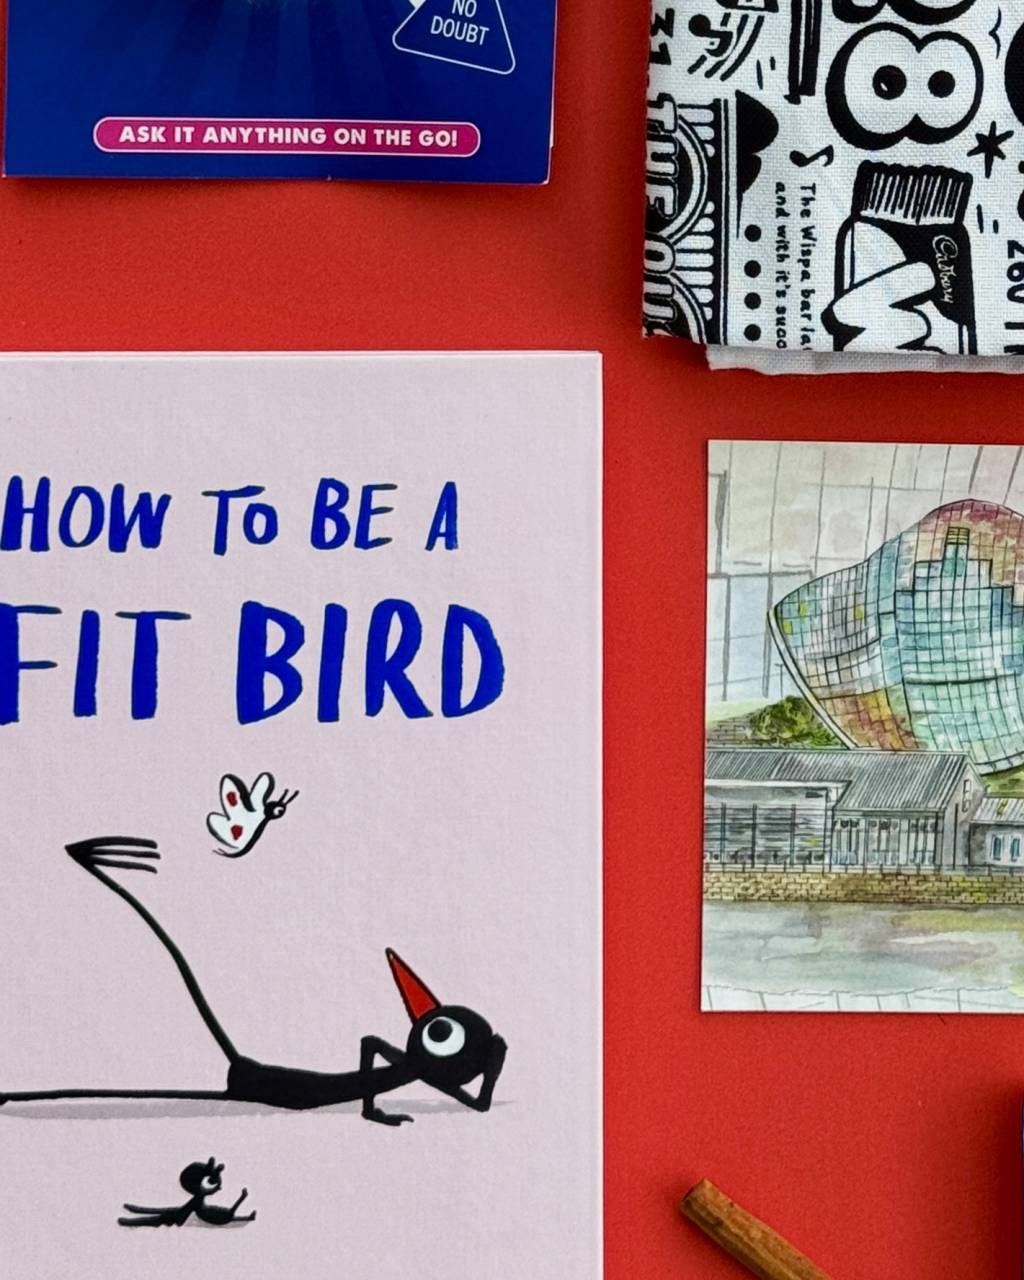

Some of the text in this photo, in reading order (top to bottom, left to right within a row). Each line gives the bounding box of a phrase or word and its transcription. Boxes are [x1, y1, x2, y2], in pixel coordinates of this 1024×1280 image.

[430, 16, 490, 46] DOUBT
[119, 125, 458, 147] ASK IT ANYTHING ON THE GO!
[775, 182, 791, 218] and
[800, 182, 817, 219] The
[776, 224, 791, 263] with
[797, 225, 817, 282] Wispa
[775, 271, 791, 299] it's
[800, 288, 816, 322] bar
[0, 476, 172, 552] HOW
[310, 477, 398, 550] BE
[425, 481, 459, 551] A
[0, 599, 505, 725] FIT BIRD
